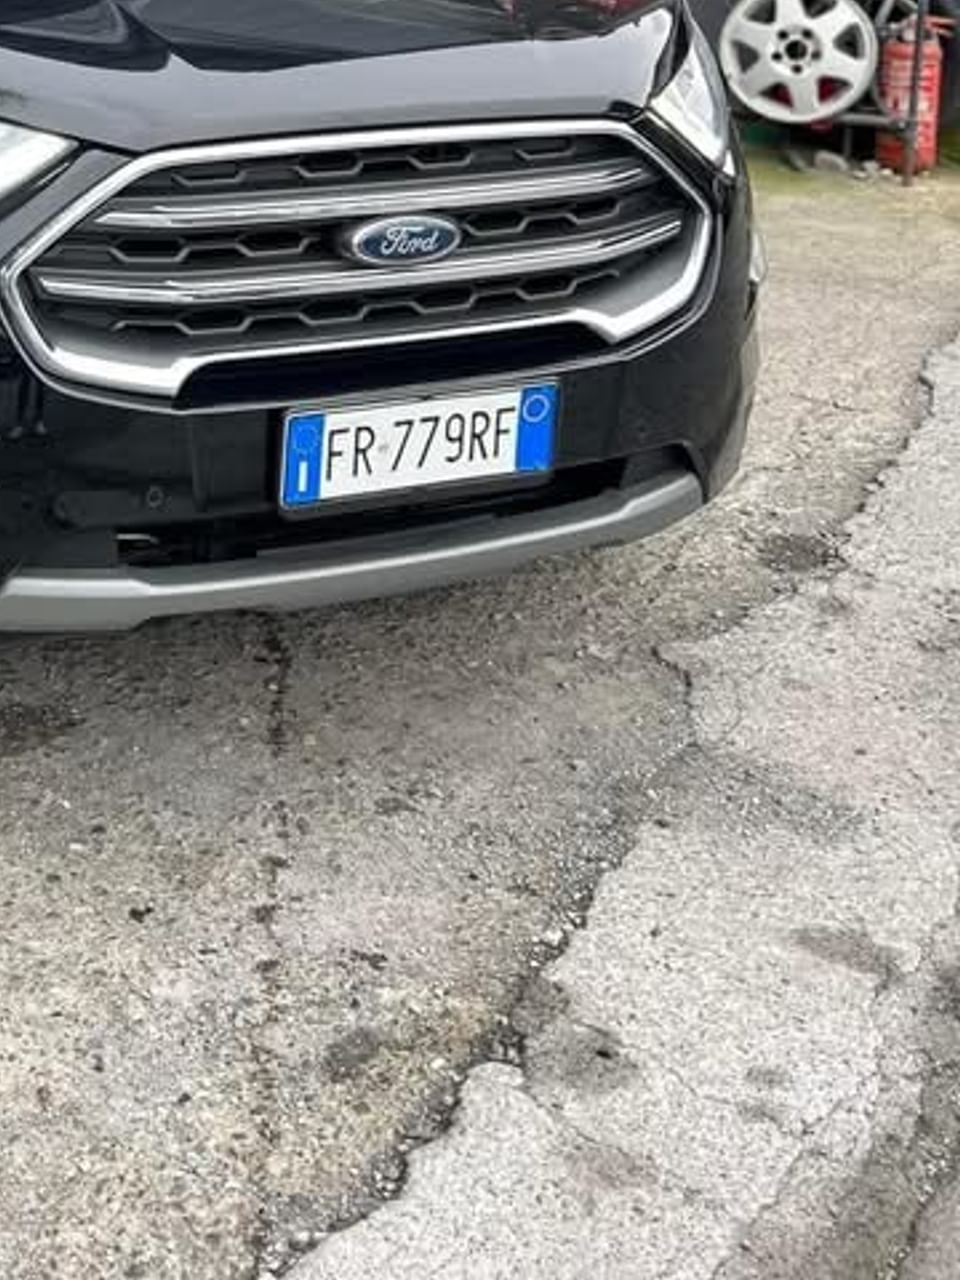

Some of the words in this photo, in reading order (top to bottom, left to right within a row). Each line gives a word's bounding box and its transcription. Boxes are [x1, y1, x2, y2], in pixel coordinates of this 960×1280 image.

[380, 225, 440, 256] Ford
[325, 426, 376, 482] FR
[391, 406, 517, 472] 779RF
